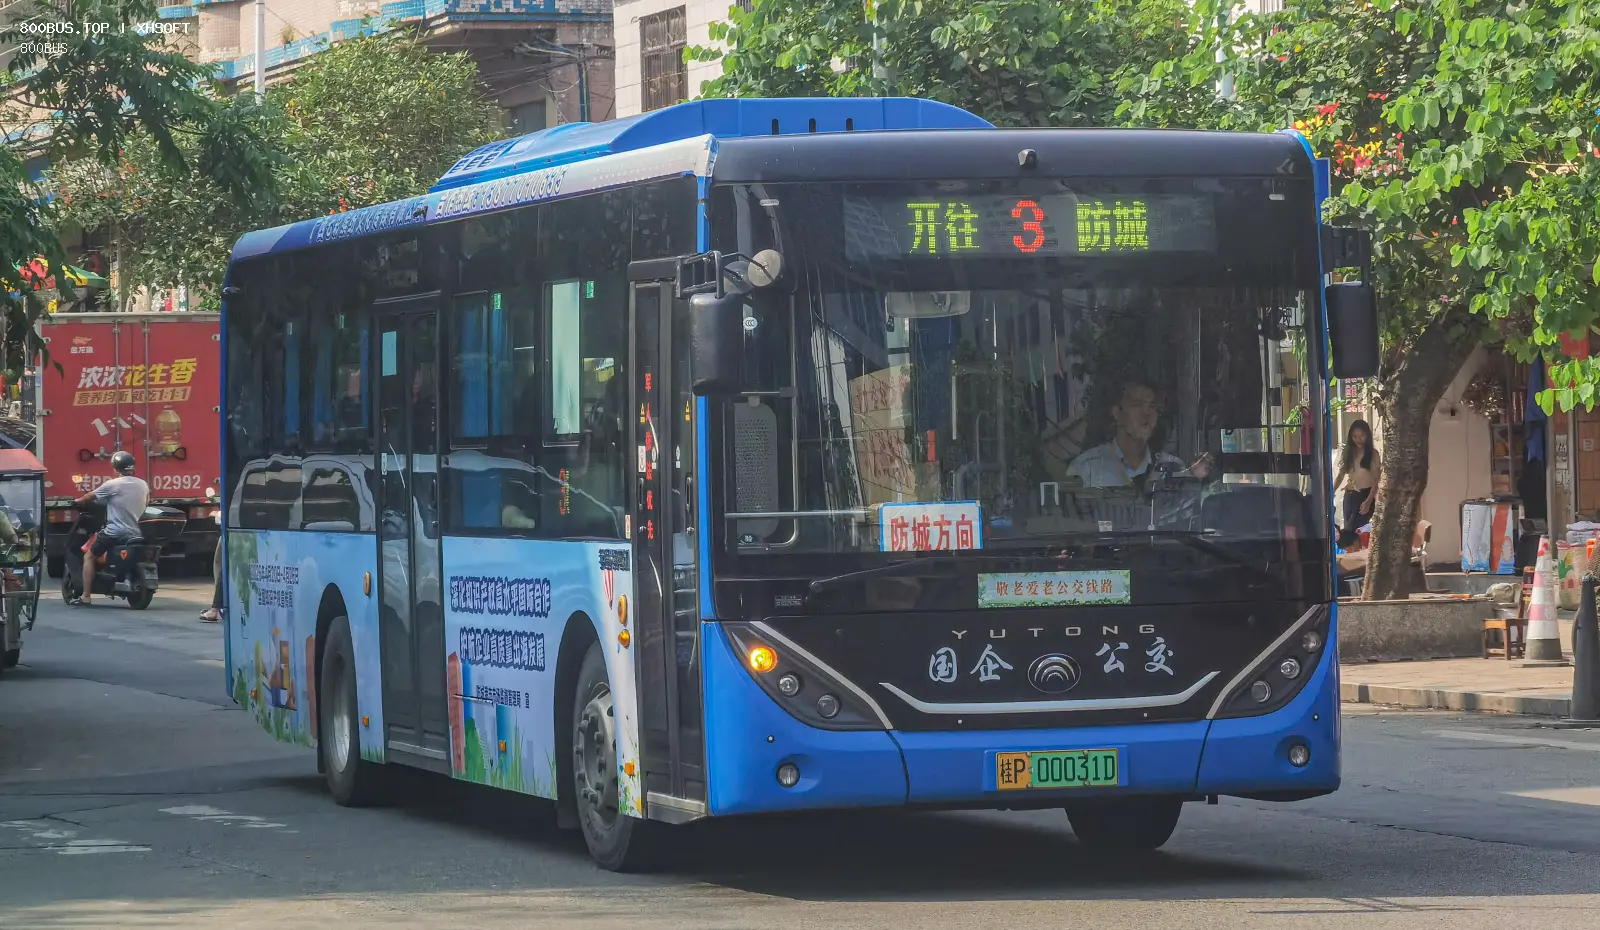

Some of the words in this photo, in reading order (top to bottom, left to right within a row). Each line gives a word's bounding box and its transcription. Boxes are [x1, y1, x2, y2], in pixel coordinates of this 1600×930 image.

[906, 202, 979, 254] 开往
[1011, 200, 1044, 253] 3
[1076, 200, 1149, 252] 防城
[77, 358, 198, 389] 浓浓花生香
[152, 474, 201, 490] 02992
[890, 513, 974, 551] 防城方向
[996, 578, 1113, 597] 敬老爱老公交线路
[951, 624, 1155, 640] YUTONG
[928, 643, 1014, 683] 国企
[1095, 636, 1174, 676] 公交
[1001, 758, 1026, 784] 桂P
[1037, 755, 1116, 782] 00031D
